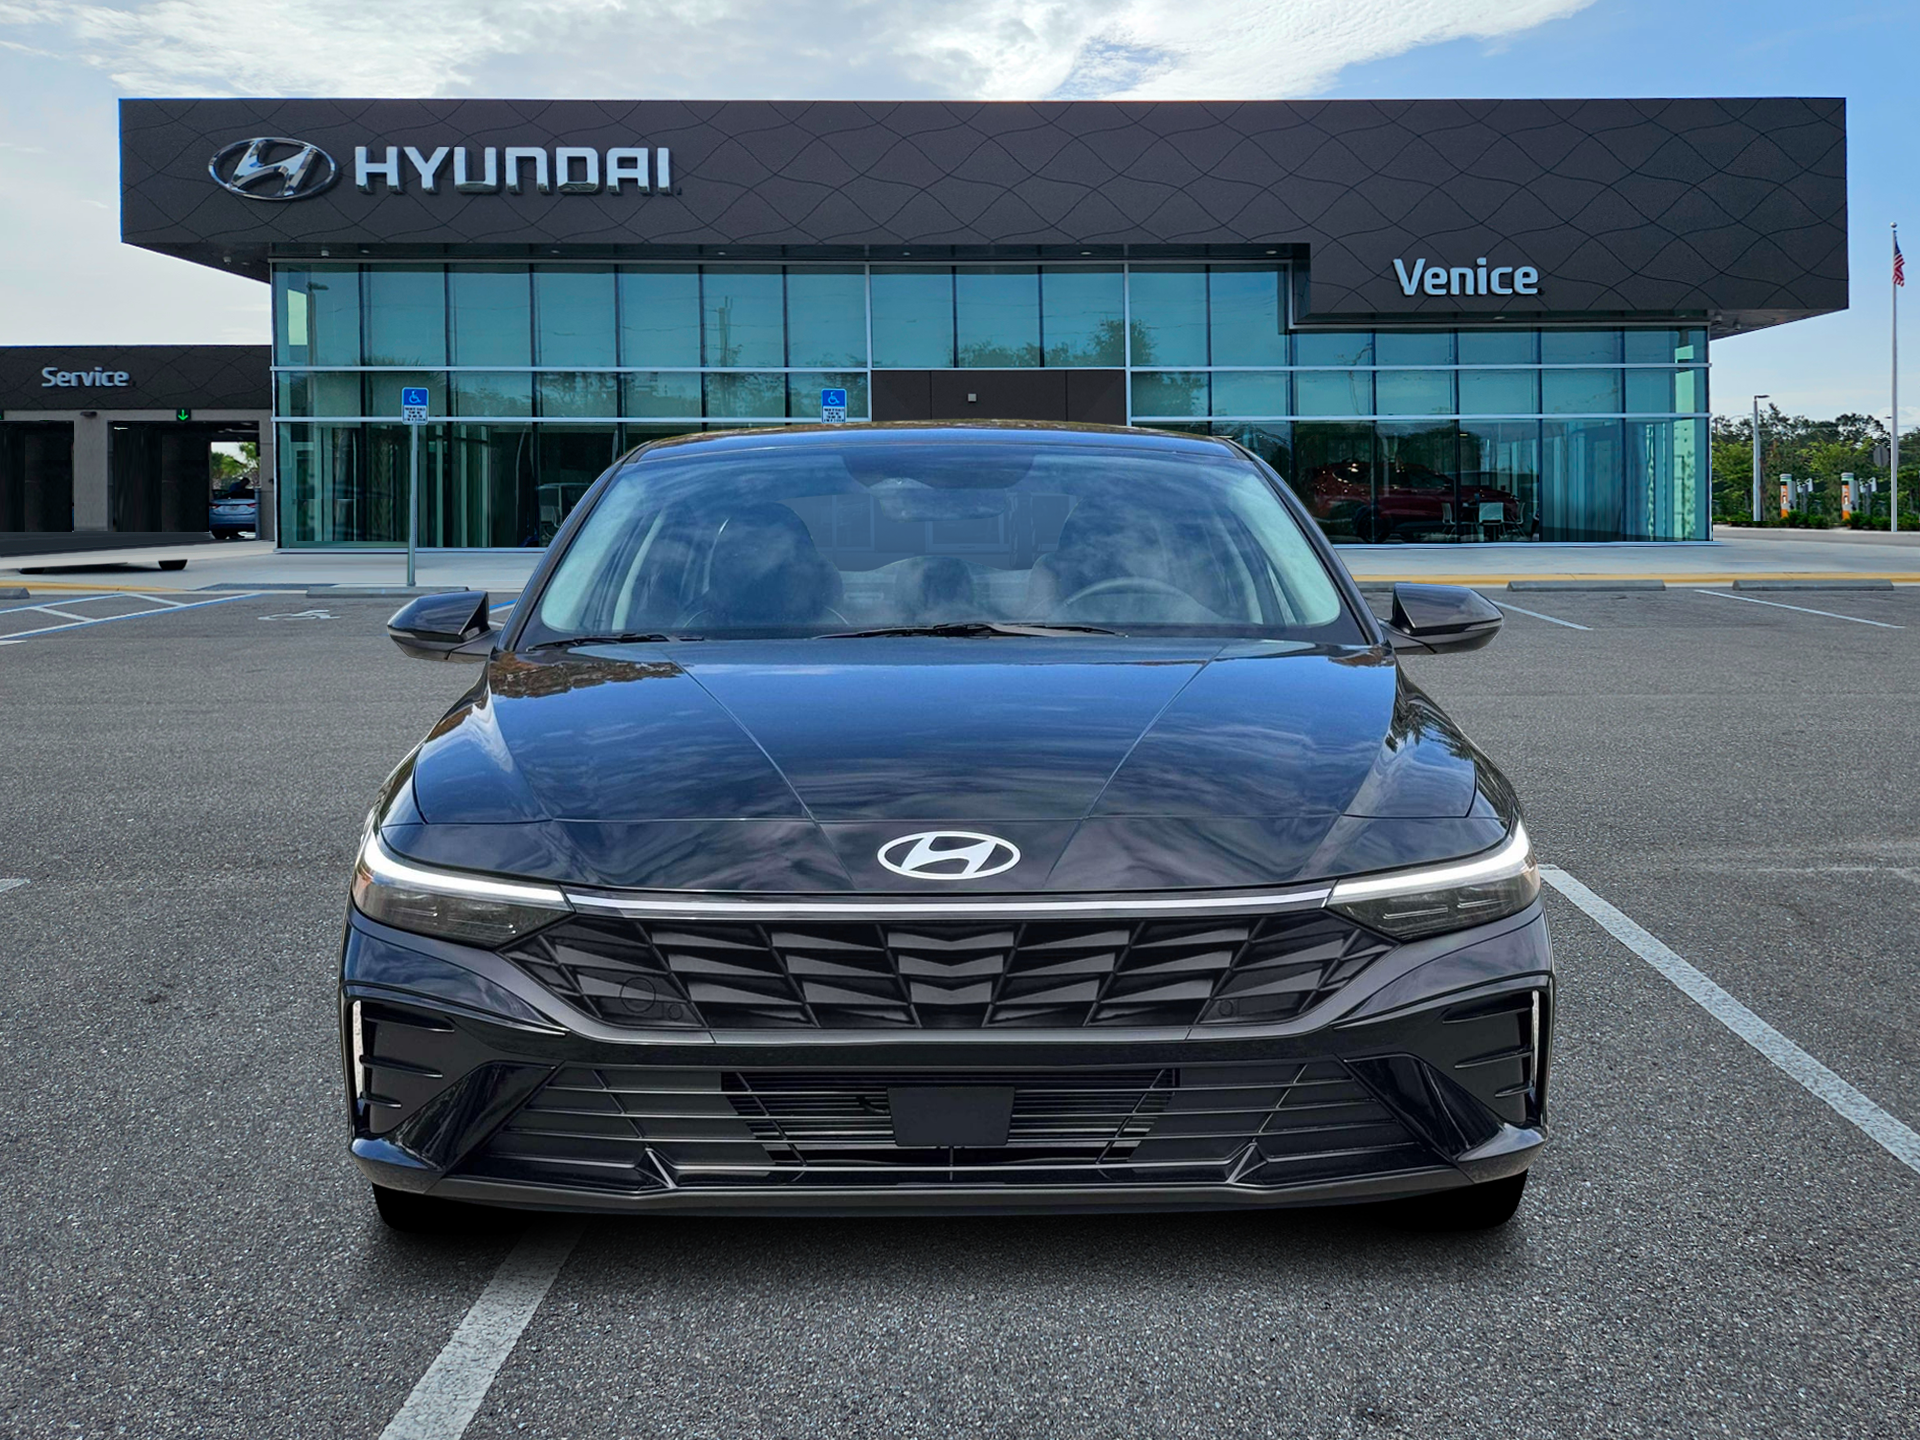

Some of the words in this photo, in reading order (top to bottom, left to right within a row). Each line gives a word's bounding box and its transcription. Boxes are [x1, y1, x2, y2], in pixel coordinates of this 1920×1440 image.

[354, 146, 671, 194] HYUNDAI
[1392, 257, 1539, 296] Venice
[41, 366, 130, 387] Service
